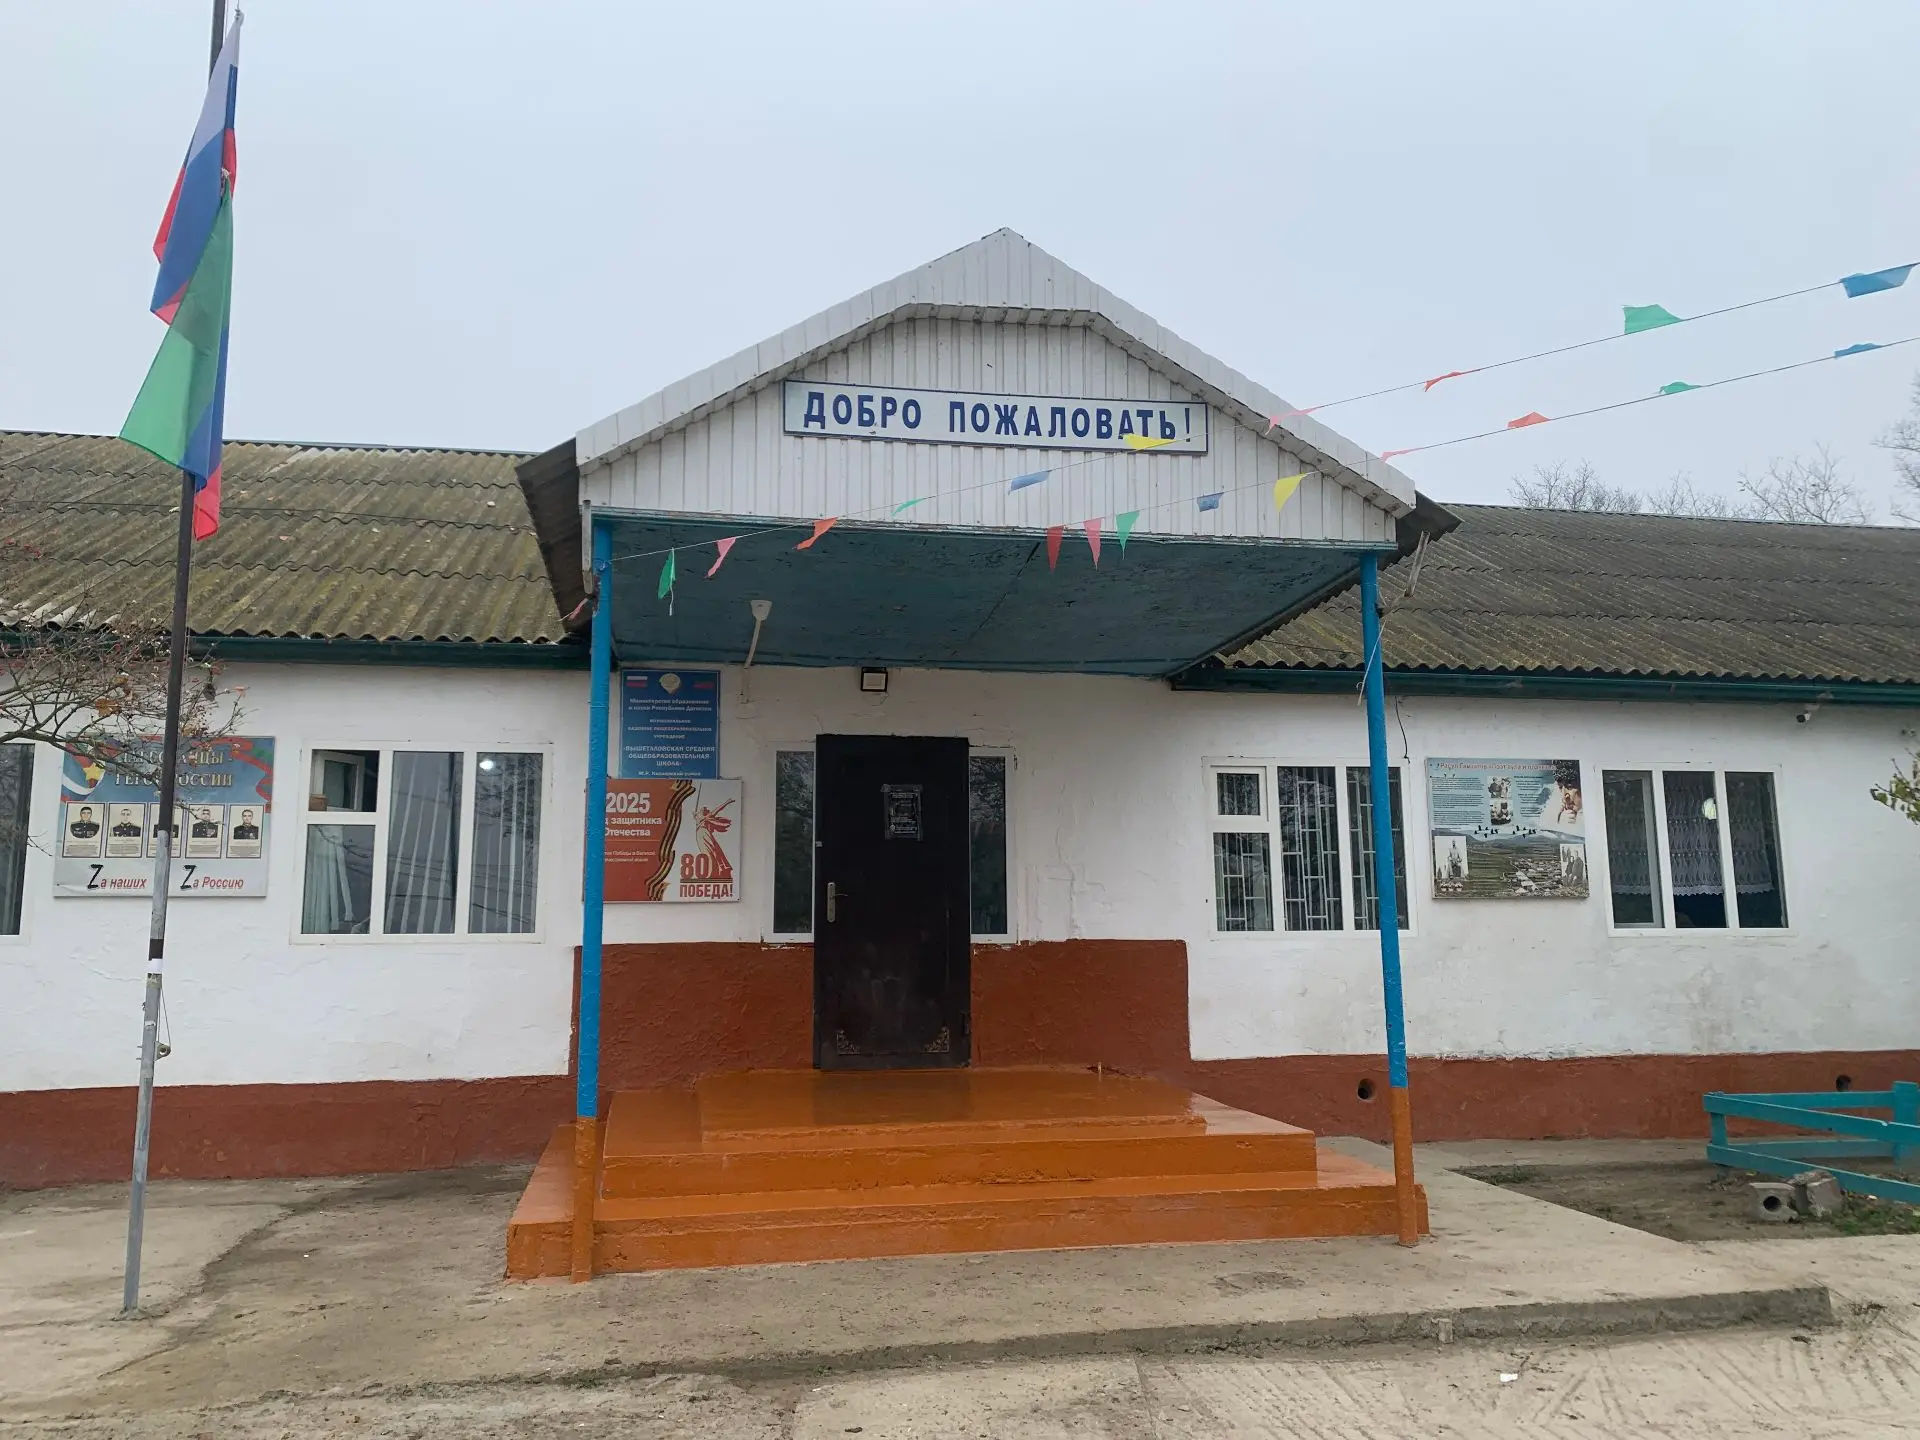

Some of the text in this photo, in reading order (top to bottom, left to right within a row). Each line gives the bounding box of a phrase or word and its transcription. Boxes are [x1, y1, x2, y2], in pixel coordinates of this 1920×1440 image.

[803, 391, 1192, 443] ДОБРО ПОЖАЛОВАТЬ!
[605, 792, 651, 814] 2025
[611, 817, 662, 826] защитника
[680, 853, 710, 878] 80
[109, 877, 147, 889] наших
[202, 876, 244, 889] Россию
[679, 884, 734, 899] ПОБЕДА!
